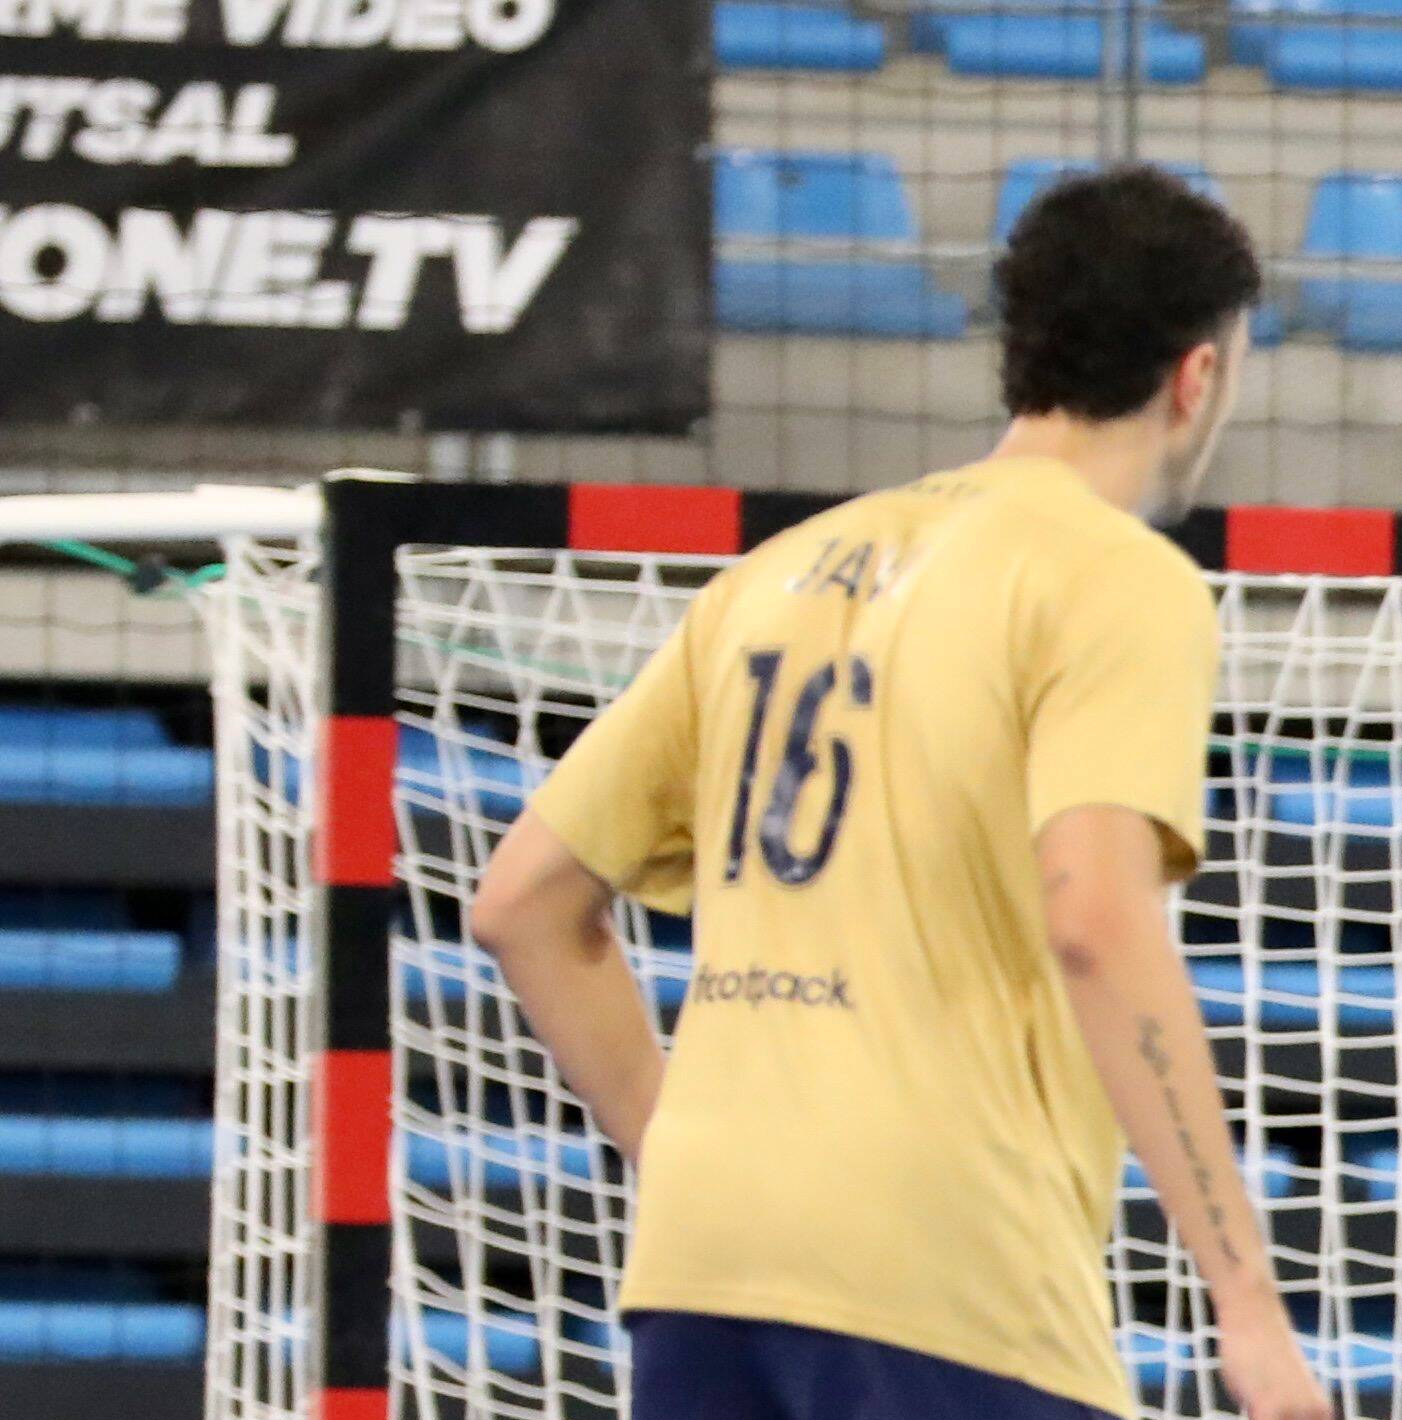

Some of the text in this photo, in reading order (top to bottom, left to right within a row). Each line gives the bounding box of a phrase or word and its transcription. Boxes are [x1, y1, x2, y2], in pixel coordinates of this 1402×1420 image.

[222, 0, 556, 53] VIDEO
[0, 75, 297, 167] TSAL
[0, 202, 580, 334] ONE.TV
[722, 645, 874, 887] 16
